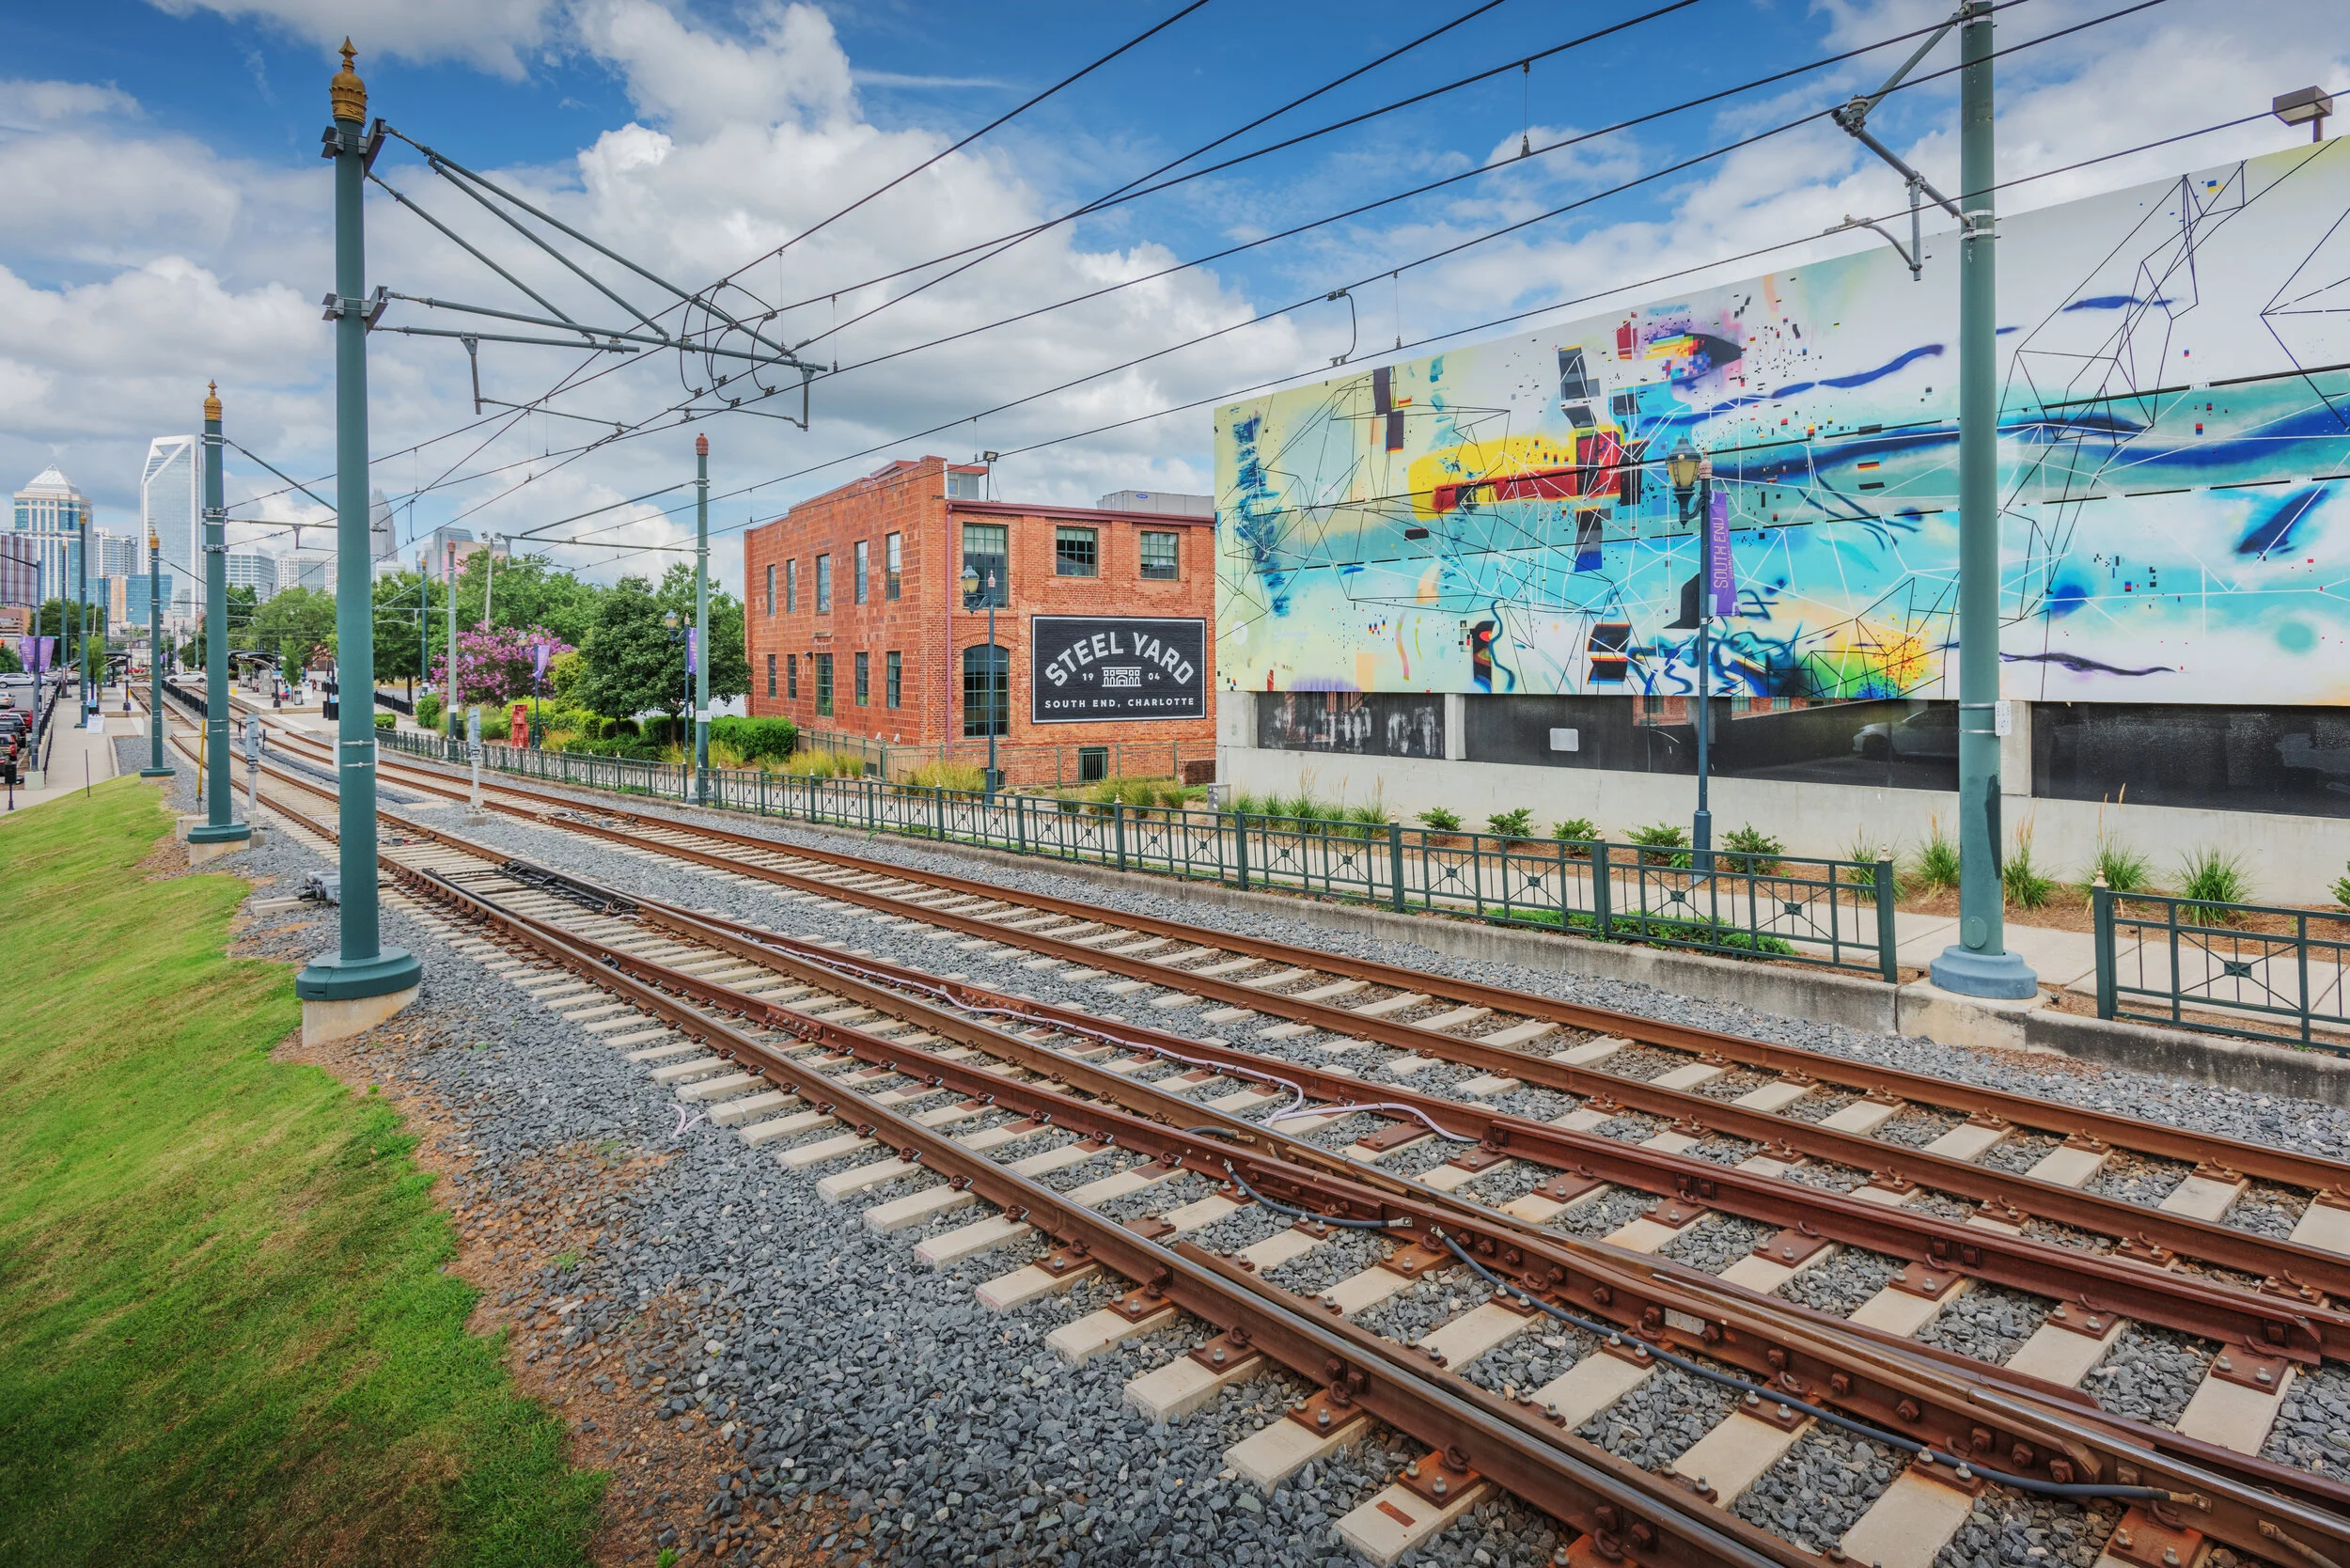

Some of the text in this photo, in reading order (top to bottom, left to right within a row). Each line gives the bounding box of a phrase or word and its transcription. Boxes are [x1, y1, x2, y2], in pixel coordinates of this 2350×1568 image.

[1714, 545, 1729, 588] SOUTH
[1044, 631, 1195, 687] STEEL YARD
[1082, 672, 1160, 682] 19 04
[1044, 698, 1194, 709] SOUTH END, CHARLOTTE
